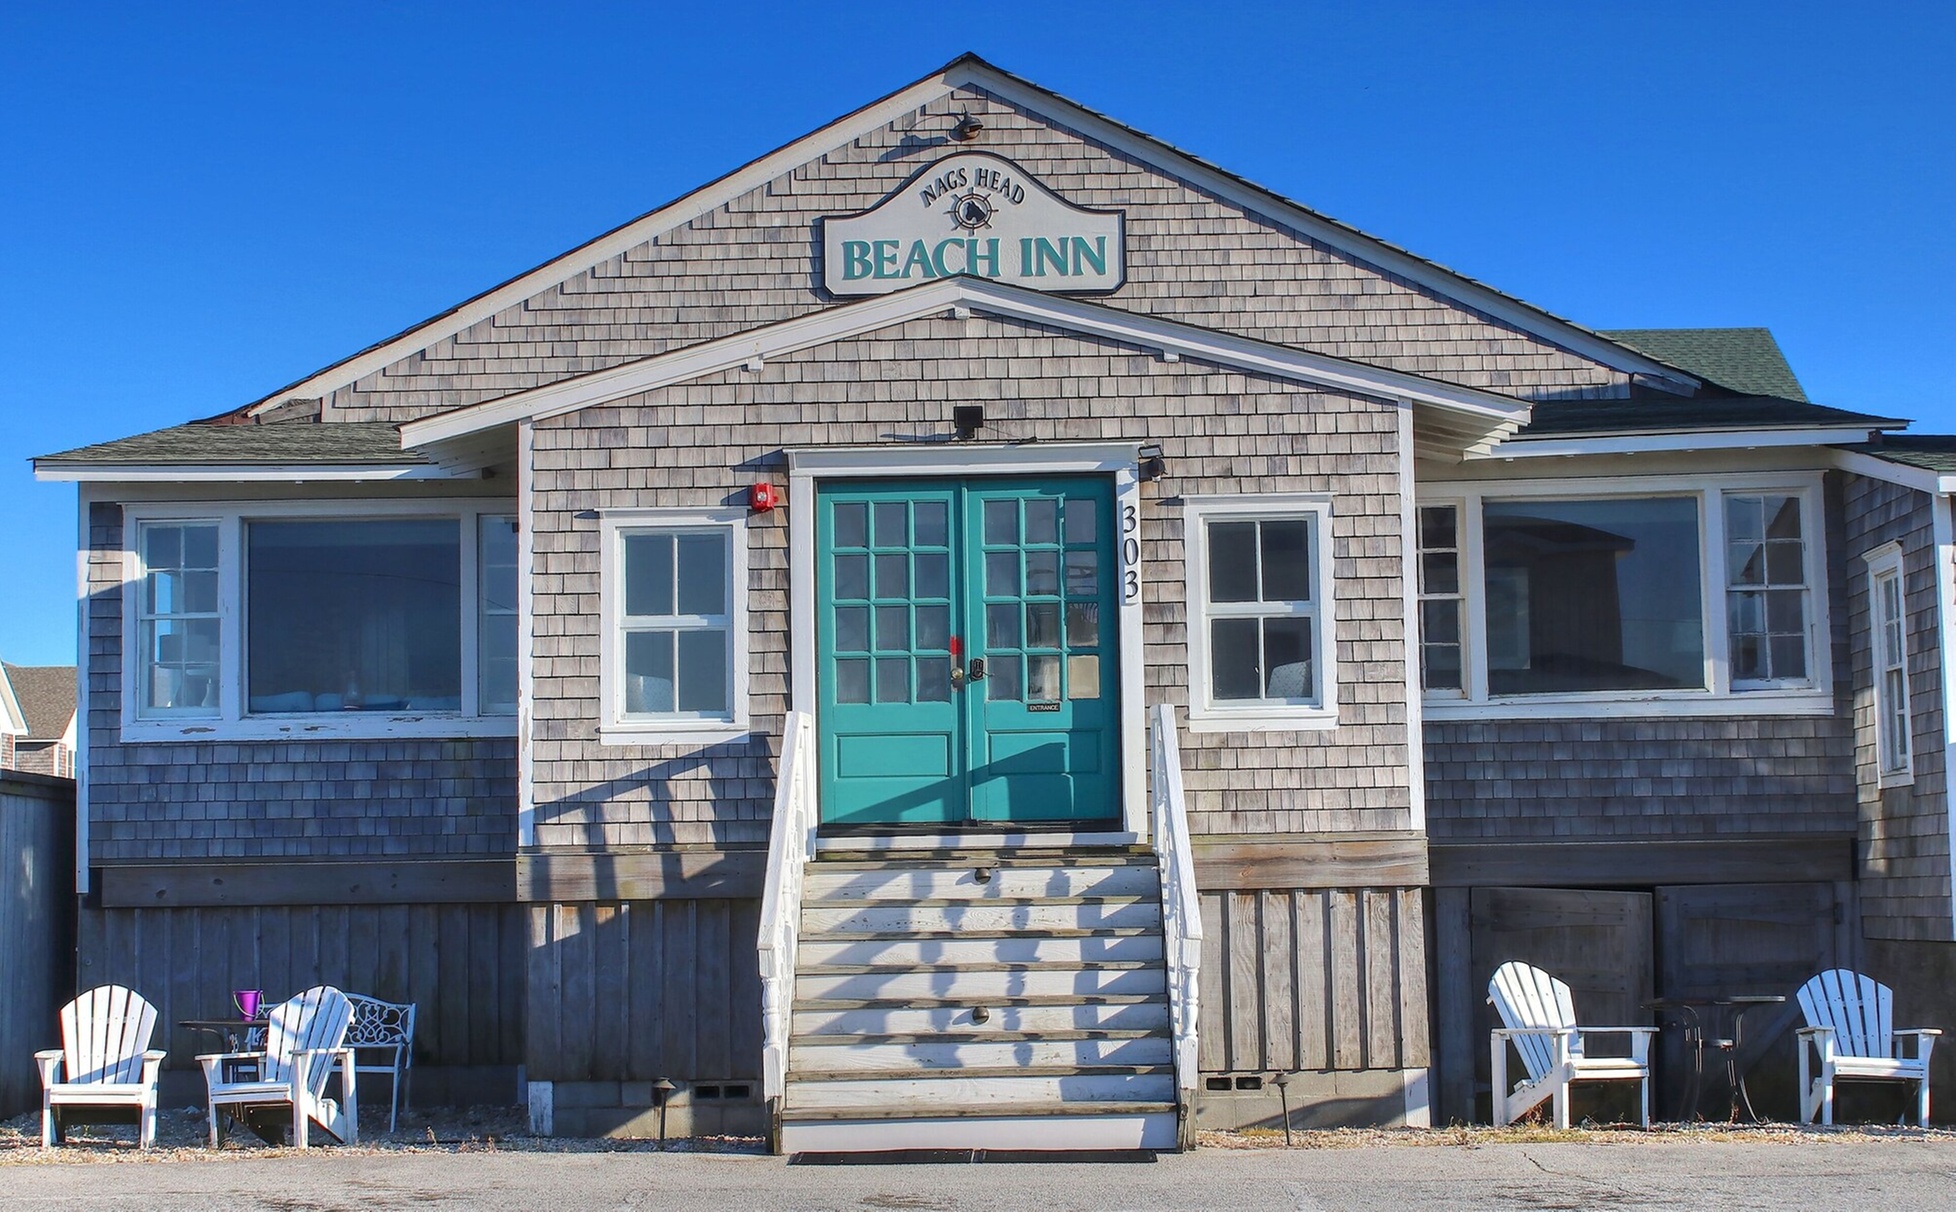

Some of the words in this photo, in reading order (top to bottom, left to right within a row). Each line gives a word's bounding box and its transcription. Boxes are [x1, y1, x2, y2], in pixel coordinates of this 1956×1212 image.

[921, 167, 968, 207] NAGS
[974, 167, 1026, 204] HEAD
[841, 237, 1001, 281] BEACH
[1018, 235, 1107, 277] INN
[1122, 505, 1139, 599] 303
